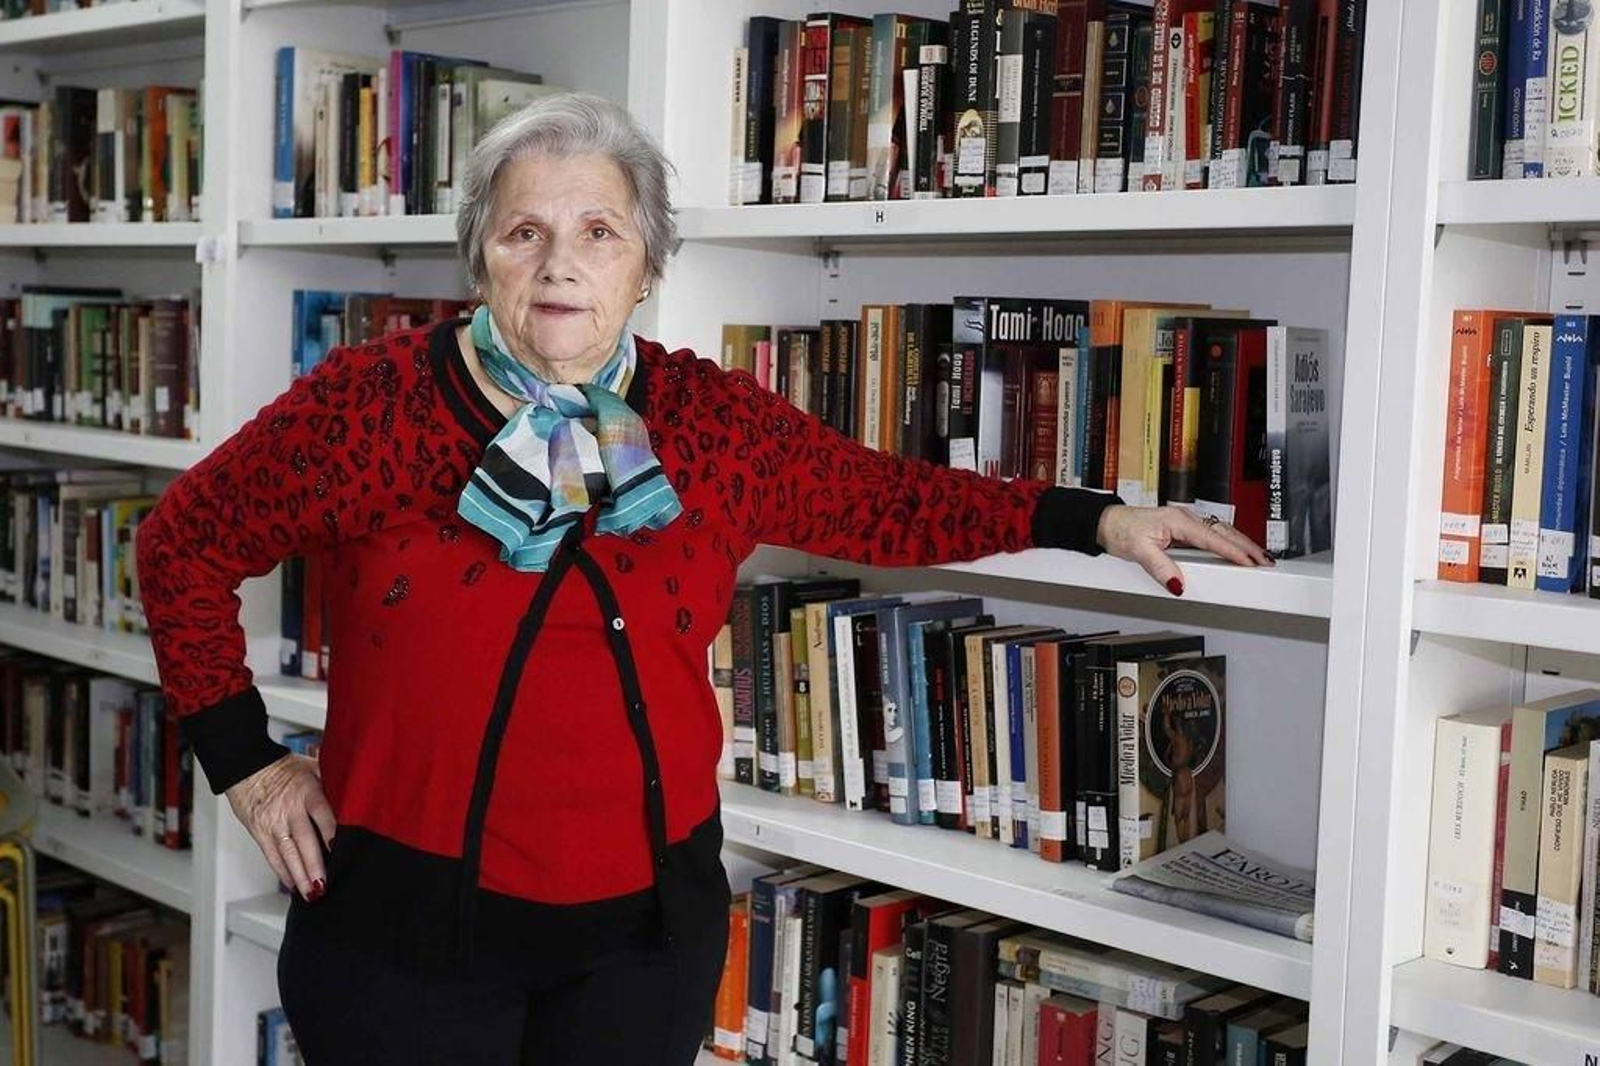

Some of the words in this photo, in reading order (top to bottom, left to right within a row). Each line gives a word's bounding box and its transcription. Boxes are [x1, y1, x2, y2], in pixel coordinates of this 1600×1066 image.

[969, 19, 980, 61] LEGENDS
[920, 66, 928, 97] HARRIS
[968, 77, 978, 103] DUNE
[1219, 58, 1227, 90] CLARK
[1558, 45, 1579, 123] ICKED
[919, 98, 928, 132] THOMAS
[1216, 91, 1224, 132] HIGGINS
[1214, 133, 1222, 160] MARY
[876, 211, 884, 222] H
[990, 304, 1032, 340] Tami
[1530, 332, 1542, 365] respiro
[952, 353, 962, 380] Hoag
[1294, 351, 1319, 383] Adiós
[1530, 367, 1538, 380] un
[1564, 356, 1572, 379] Bujold
[951, 385, 961, 411] Tami
[1290, 384, 1326, 416] Sarajevo
[1525, 382, 1537, 432] Esperando
[1561, 382, 1570, 420] McMaster
[1559, 423, 1568, 438] Lois
[1270, 449, 1282, 490] Sarajevo
[1270, 492, 1282, 520] Adiós
[1554, 494, 1564, 530] nmunidad
[762, 640, 770, 694] HUELLAS
[734, 668, 751, 722] IGNATIUS
[1119, 713, 1135, 742] Volar
[1120, 750, 1135, 786] Miedo
[1456, 782, 1464, 822] MURDOCH
[1557, 793, 1563, 802] HE
[1554, 819, 1562, 851] CONFIESO
[1211, 848, 1290, 889] FARO
[931, 942, 950, 1002] Negra
[905, 1000, 916, 1034] KING
[1585, 1053, 1598, 1066] N
